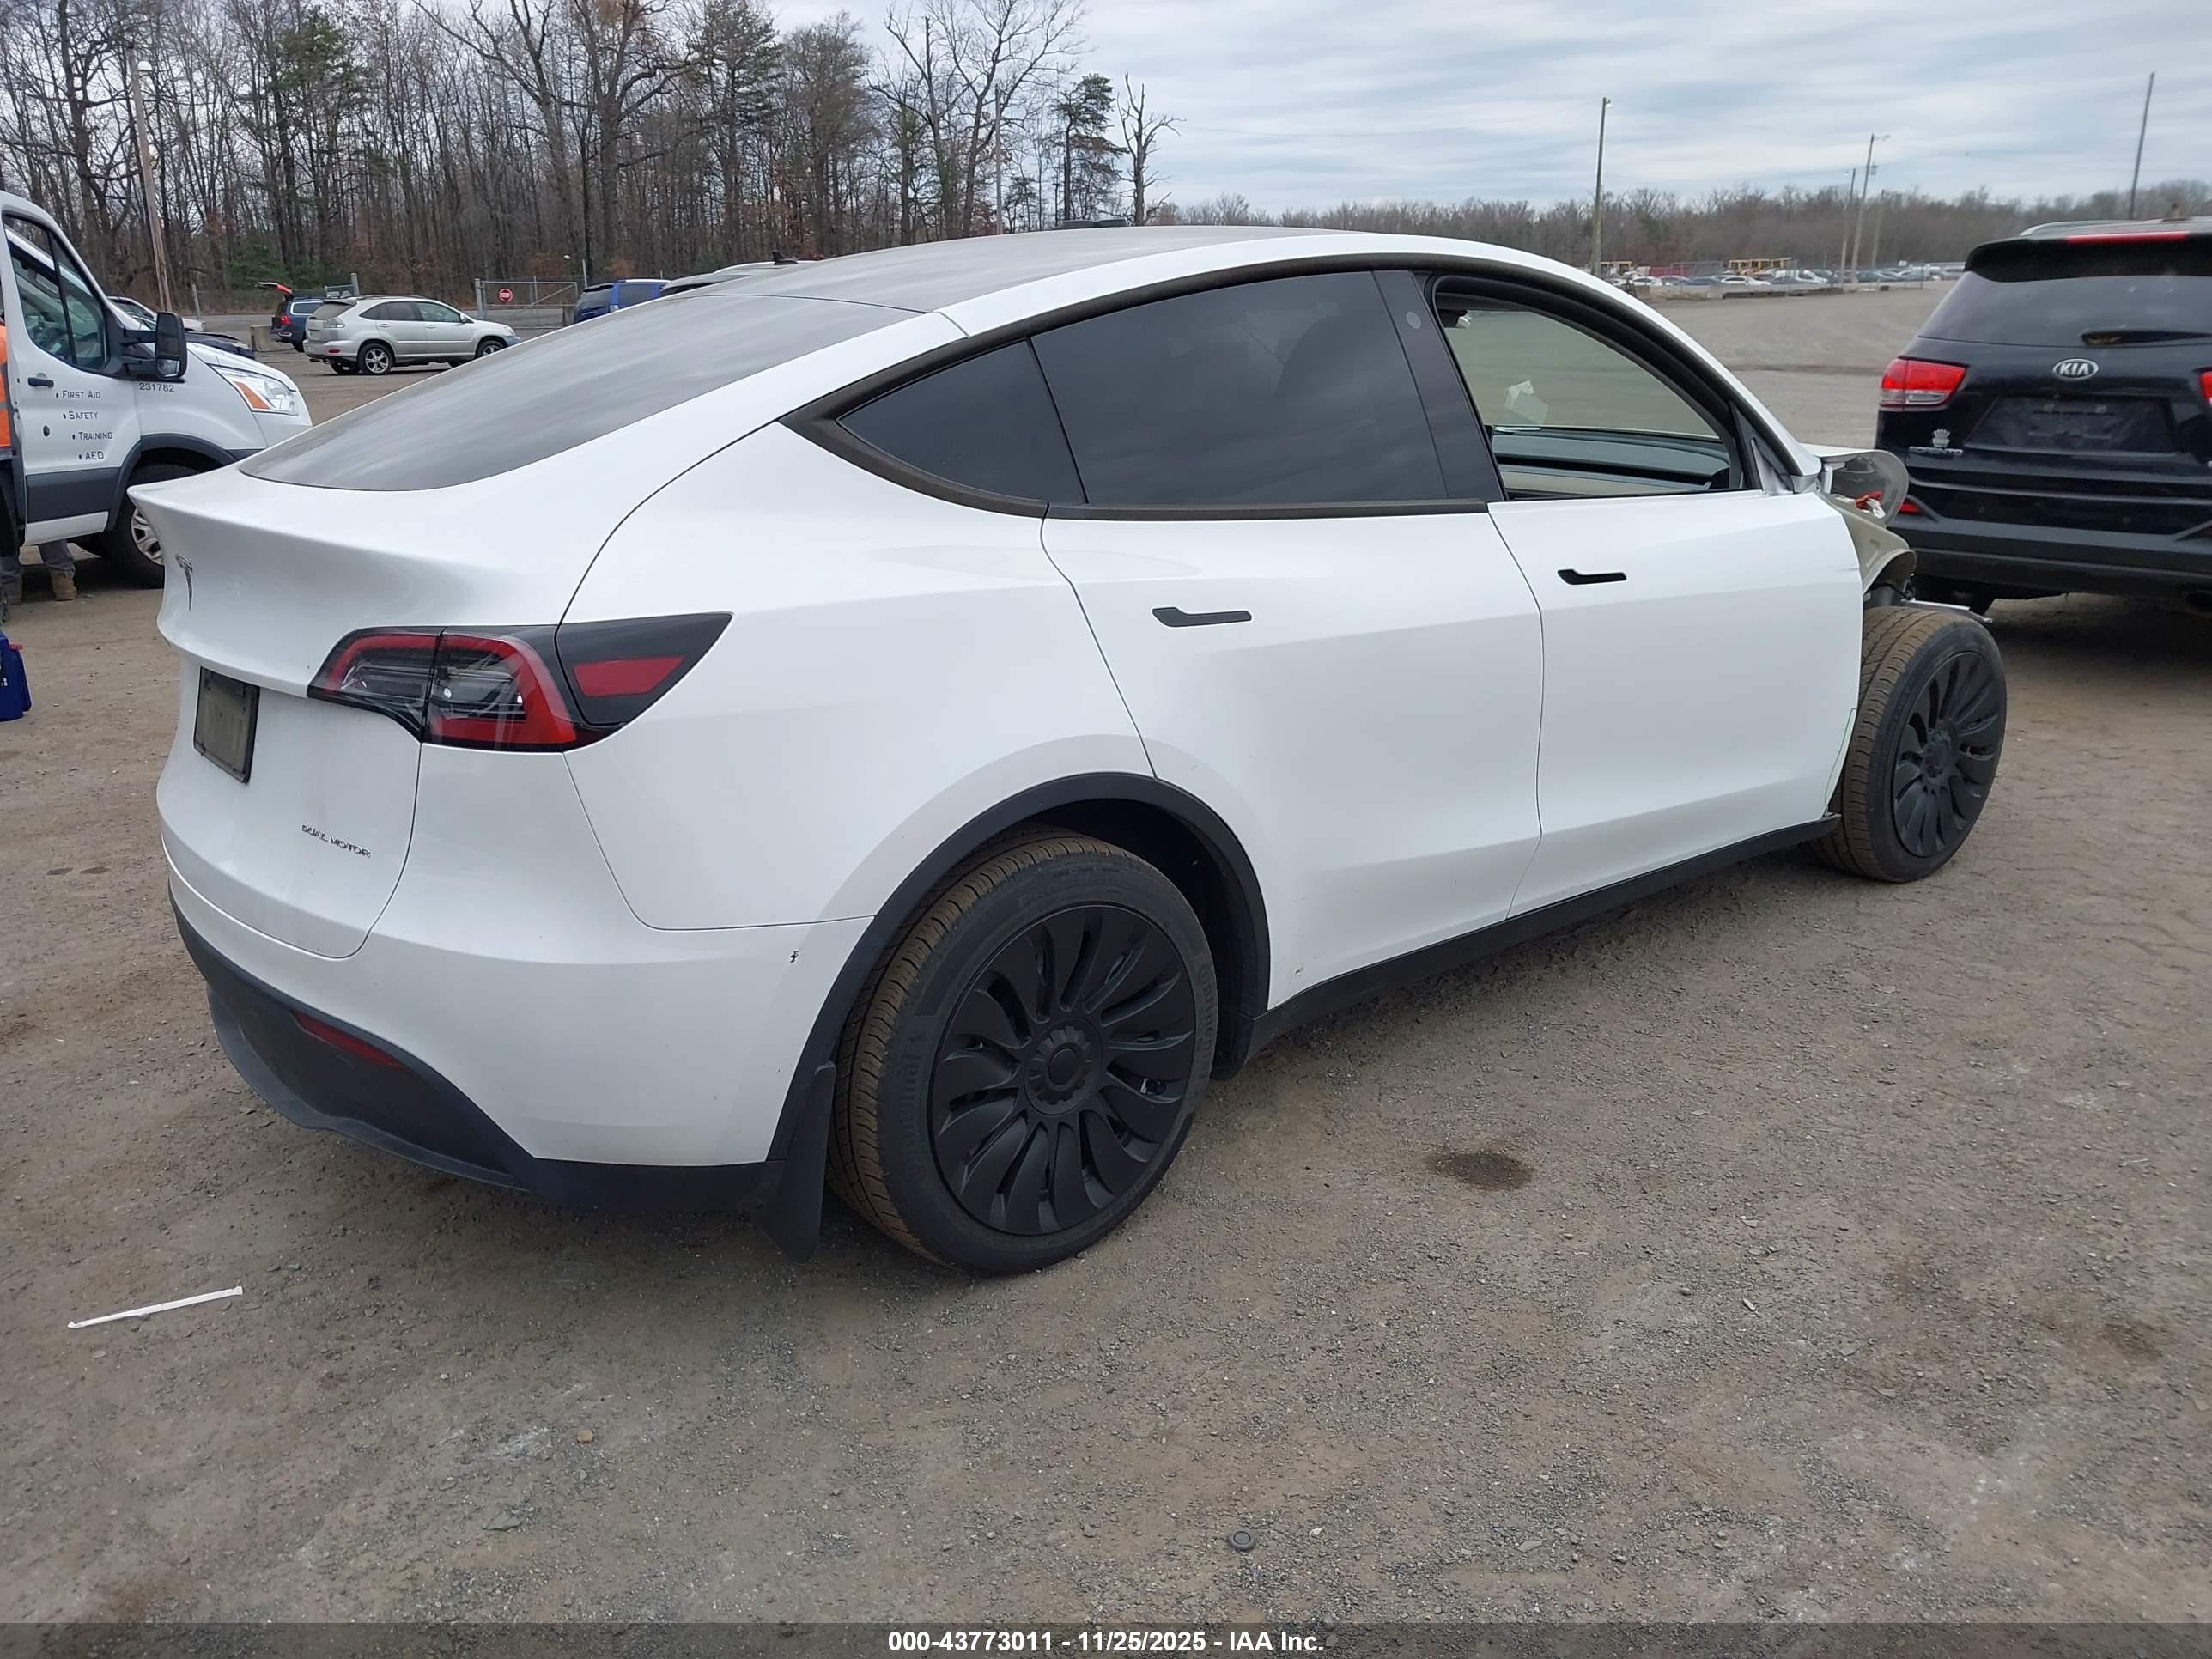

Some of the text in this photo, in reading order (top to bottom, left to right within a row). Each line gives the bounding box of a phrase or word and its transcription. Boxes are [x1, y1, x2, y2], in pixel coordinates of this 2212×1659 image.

[2059, 362, 2089, 375] KIA
[139, 382, 175, 392] 231782
[68, 410, 98, 420] SAFETY
[78, 431, 113, 441] TRAINING
[85, 451, 105, 460] AED
[301, 824, 371, 859] DUAL MOTOR
